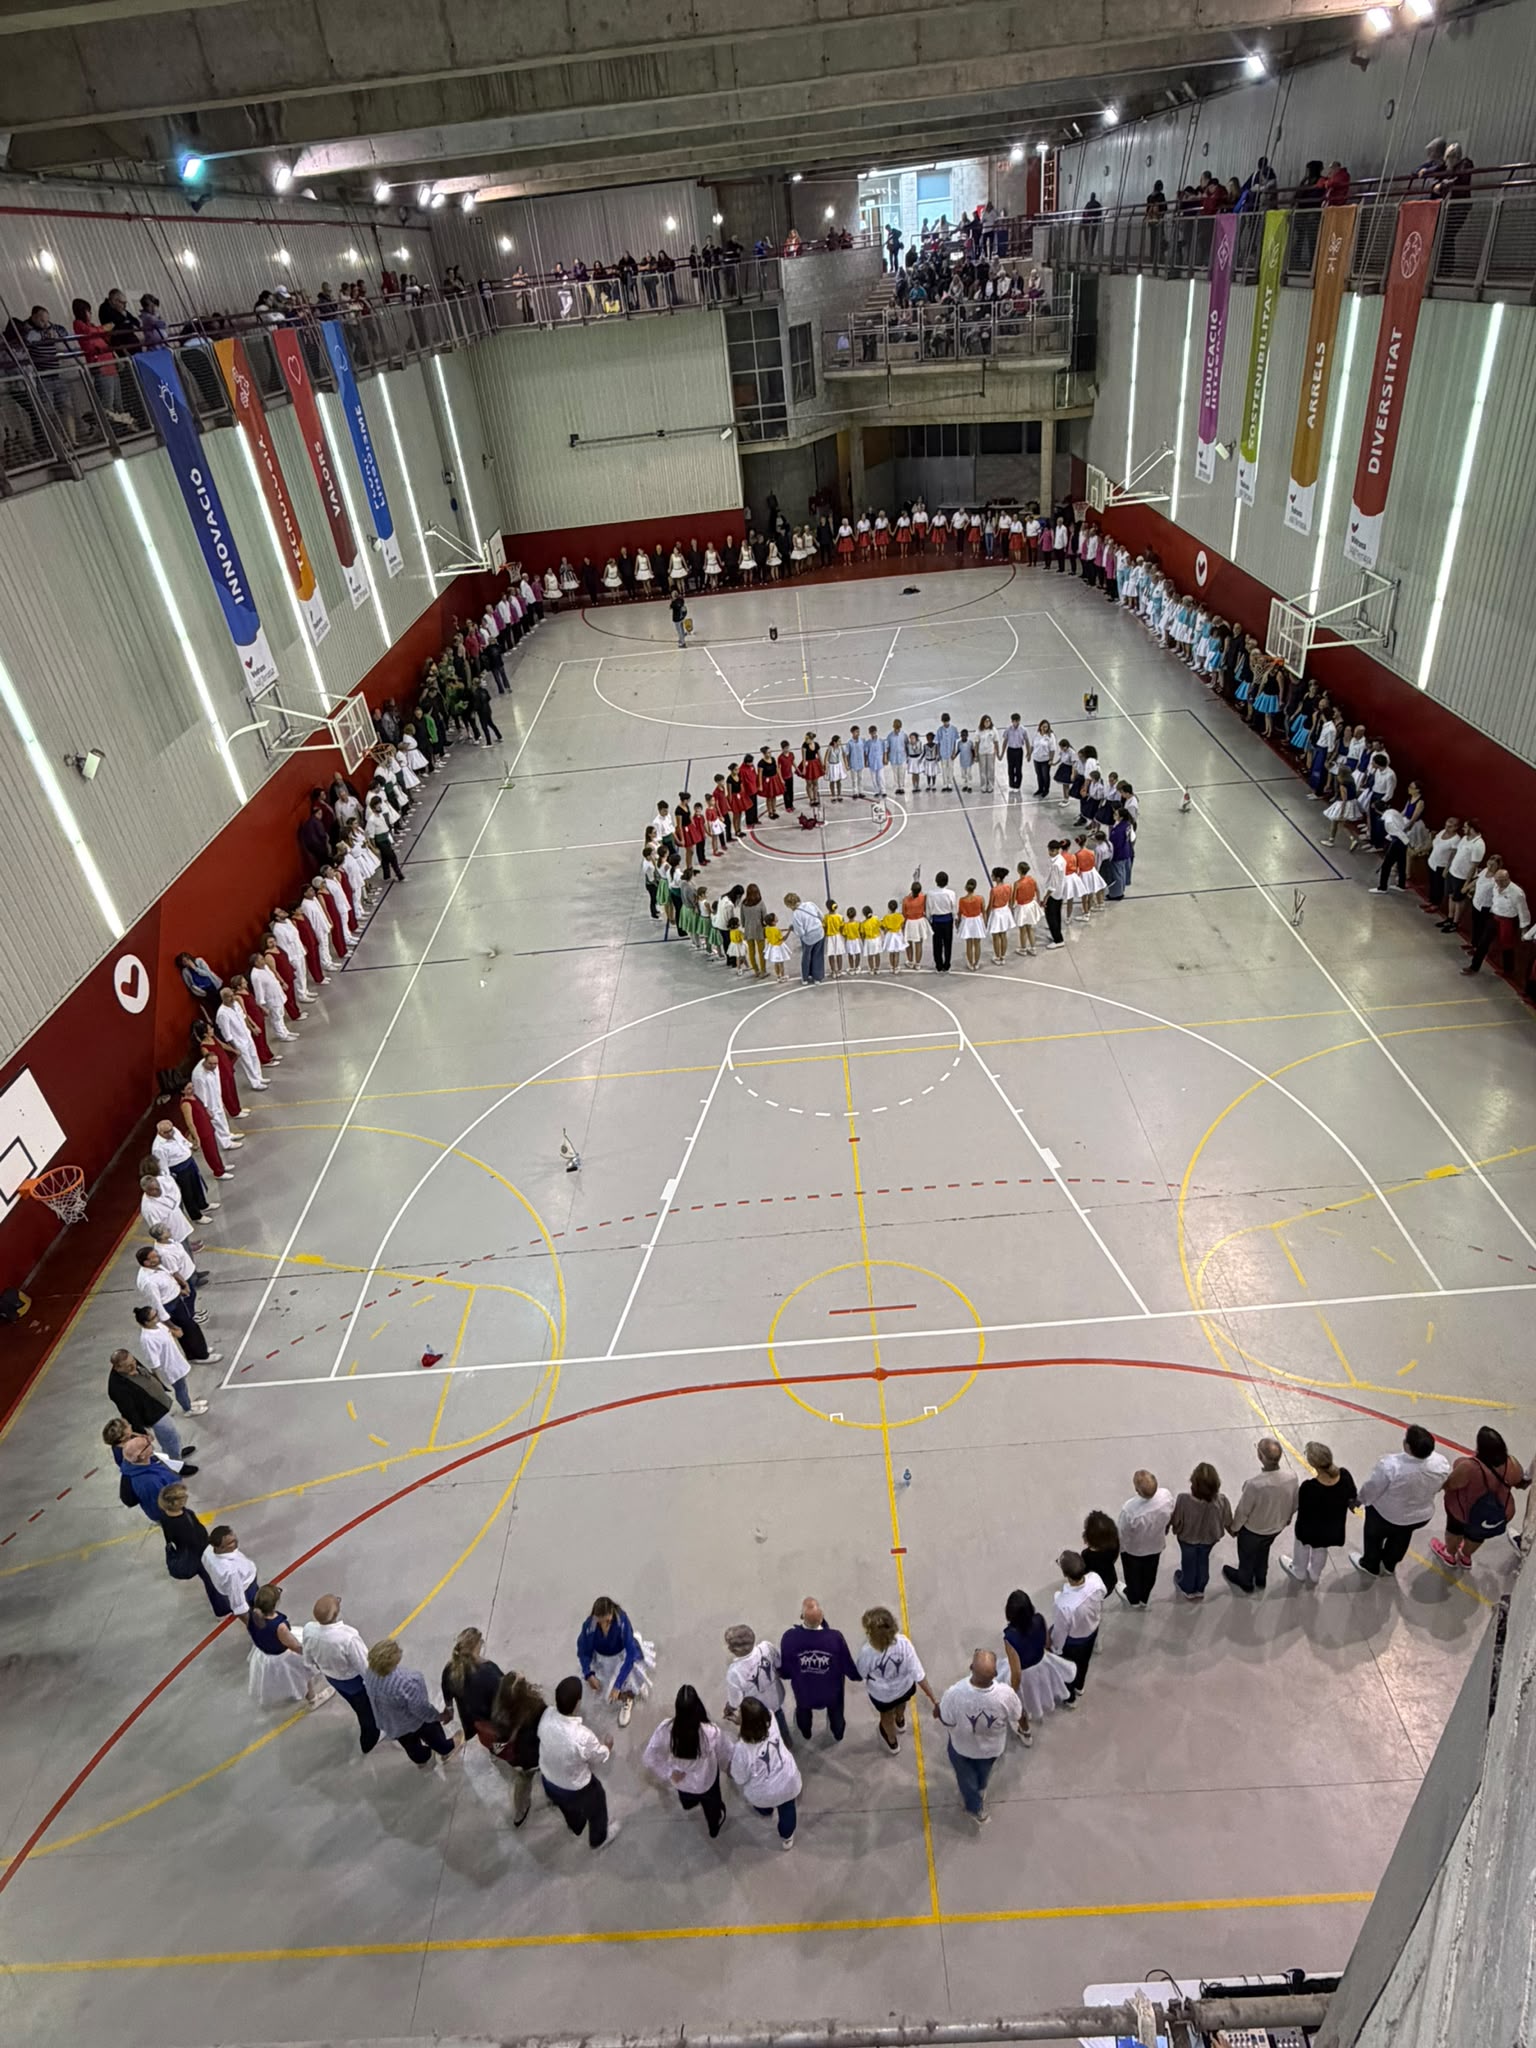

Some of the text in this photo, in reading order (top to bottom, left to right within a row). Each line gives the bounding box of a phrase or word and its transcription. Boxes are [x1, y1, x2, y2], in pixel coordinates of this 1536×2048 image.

[1205, 309, 1218, 407] EDUCACIÓ
[1248, 285, 1273, 450] SOSTENIBILITAT
[1306, 341, 1326, 429] ARRELS
[1367, 326, 1403, 475] DIVERSITAT
[190, 467, 245, 606] INNOVACIÓ
[314, 440, 342, 518] VALORS
